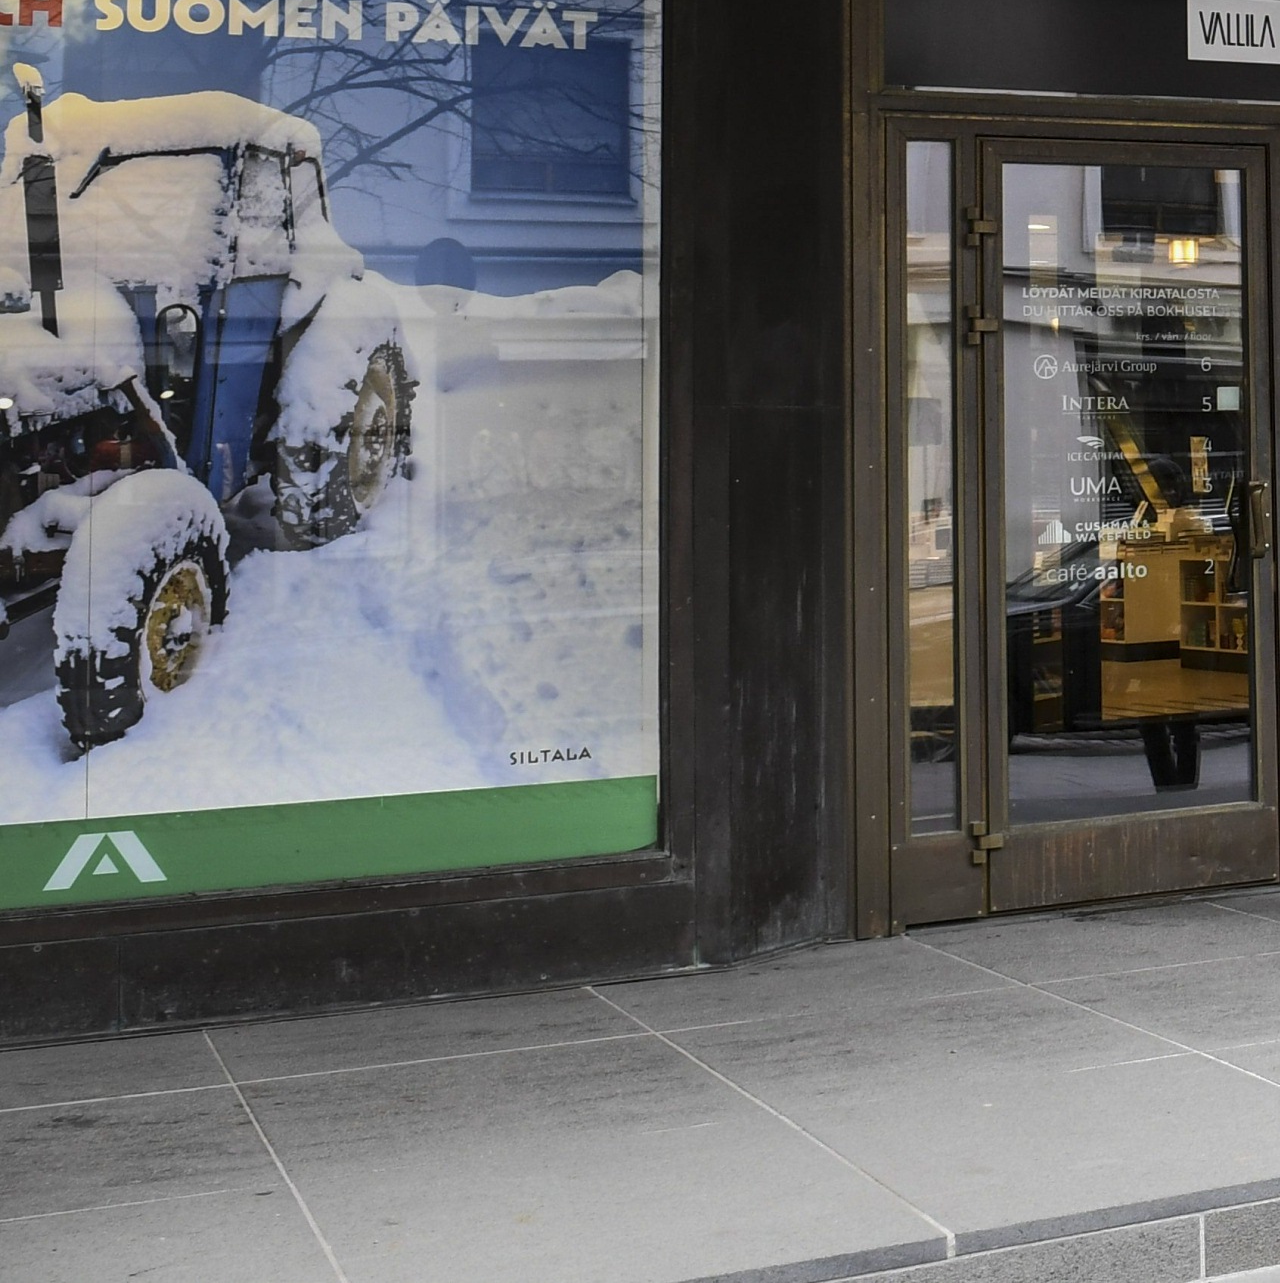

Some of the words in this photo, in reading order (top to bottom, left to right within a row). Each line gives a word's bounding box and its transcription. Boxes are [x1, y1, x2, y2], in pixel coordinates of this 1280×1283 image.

[1199, 10, 1276, 49] VALLILA
[1022, 284, 1074, 299] LÖYDÄT
[1077, 284, 1127, 299] MEIDÄT
[1130, 287, 1220, 299] KIRJATALOSTA
[1022, 305, 1043, 317] DU
[1047, 305, 1093, 317] HITTAR
[1096, 305, 1124, 317] OSS
[1127, 302, 1143, 317] PÅ
[1147, 305, 1217, 317] BOKHUSET
[1061, 360, 1118, 374] Aurejärvi
[1121, 360, 1157, 375] Group
[1201, 357, 1212, 372] 6
[1062, 395, 1130, 411] INTERA
[1202, 397, 1212, 412] 5
[1070, 476, 1122, 496] UMA
[1075, 529, 1151, 543] WAKEFIELD
[1046, 563, 1088, 583] café
[1094, 562, 1148, 580] aalto
[1204, 559, 1215, 574] 2
[509, 747, 592, 765] SILTALA
